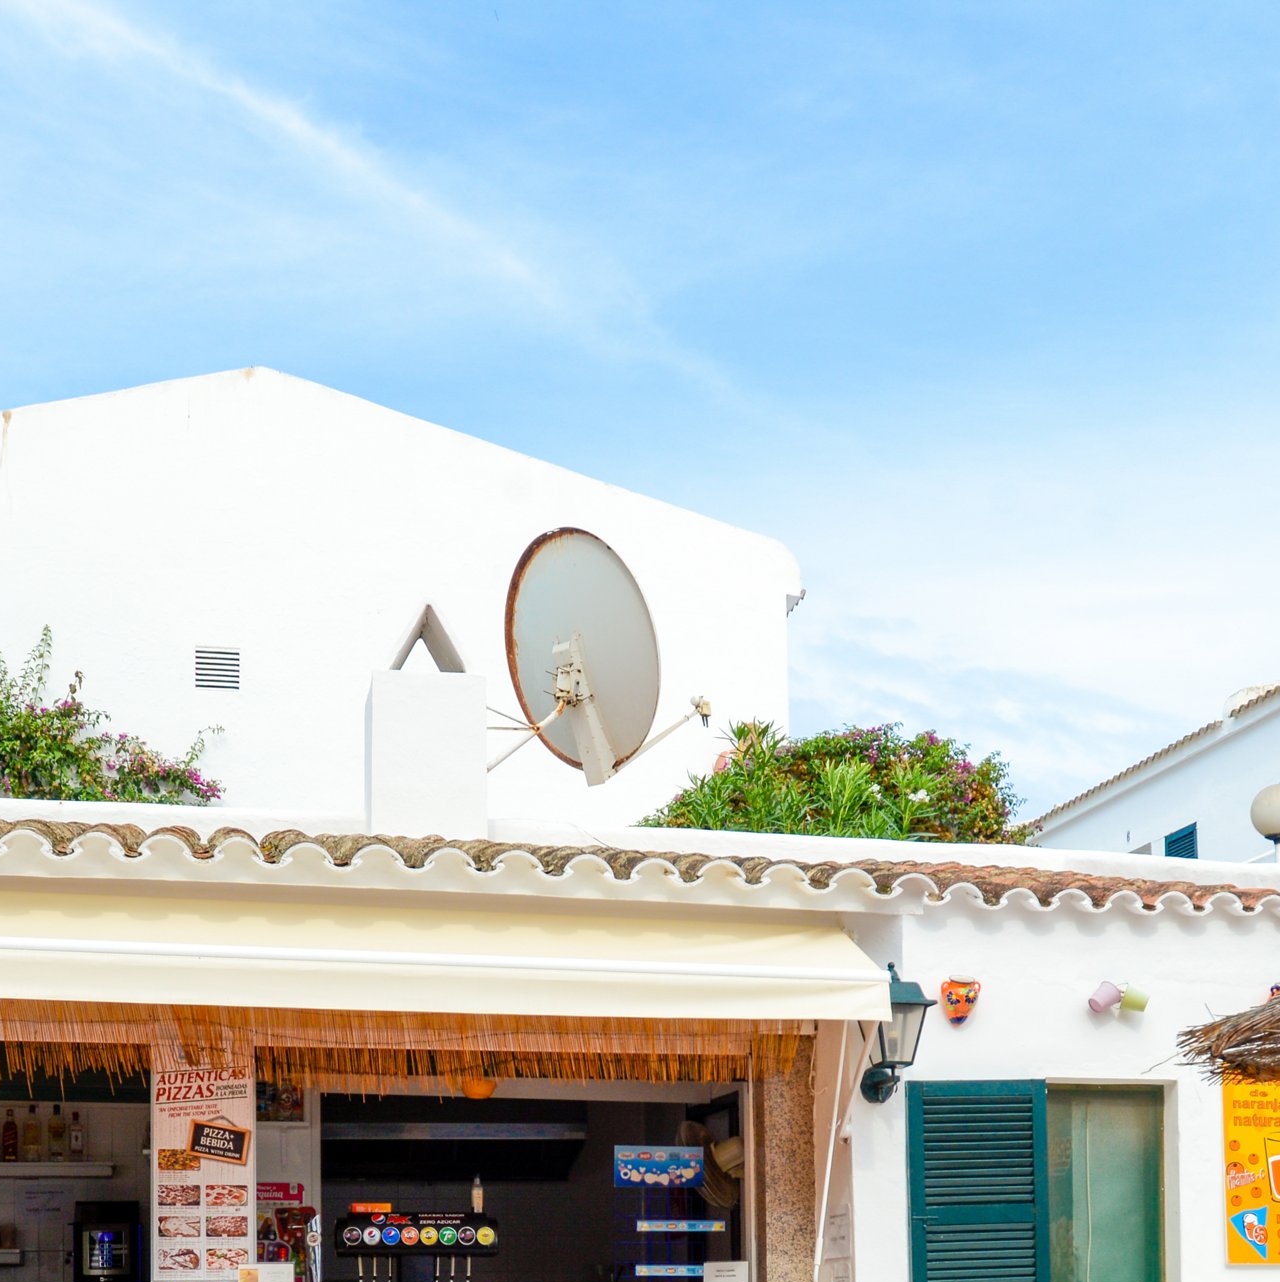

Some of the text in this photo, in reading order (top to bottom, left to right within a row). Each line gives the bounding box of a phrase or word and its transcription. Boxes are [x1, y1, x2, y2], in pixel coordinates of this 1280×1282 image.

[155, 1083, 215, 1102] PIZZAS
[1249, 1089, 1268, 1097] de
[200, 1136, 234, 1150] BEBIDA
[210, 1148, 224, 1156] WITH
